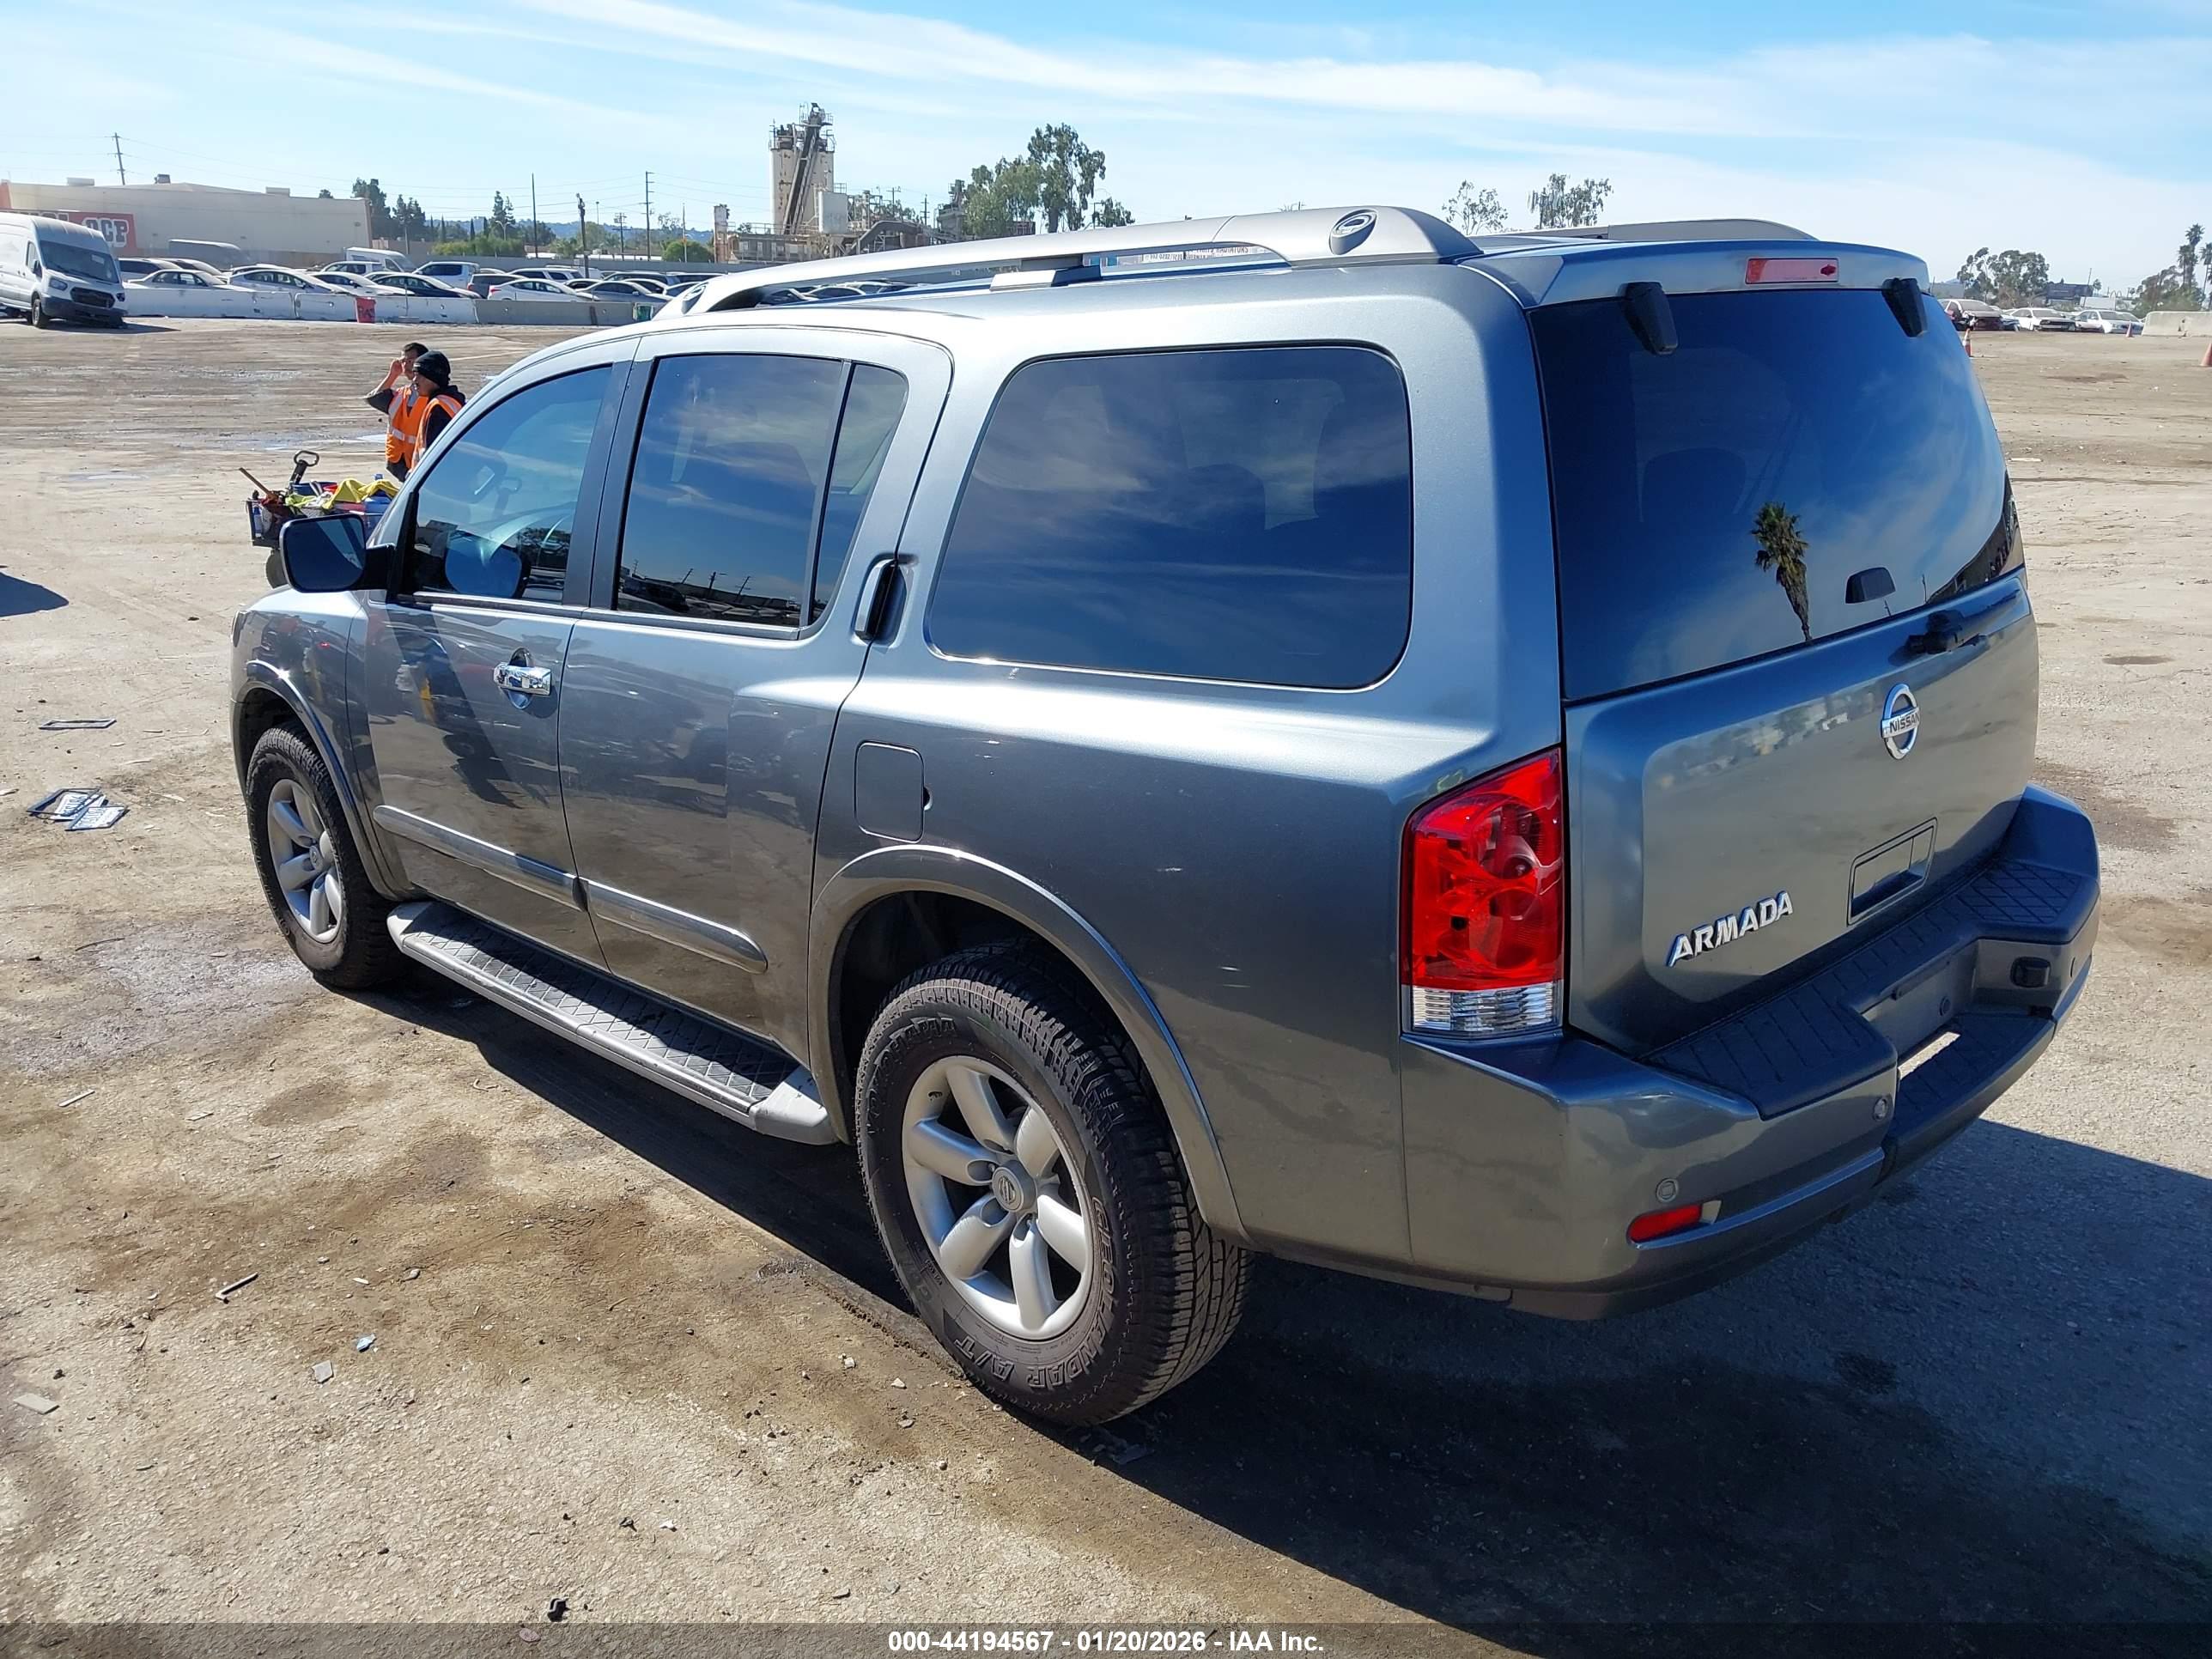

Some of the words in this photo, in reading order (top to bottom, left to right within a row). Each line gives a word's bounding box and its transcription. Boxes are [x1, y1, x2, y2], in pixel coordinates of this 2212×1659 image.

[1889, 712, 1920, 733] NISSAN
[1666, 890, 1794, 968] ARMADA
[1026, 1195, 1116, 1389] GEOLANDAR
[953, 1334, 1015, 1382] A/T
